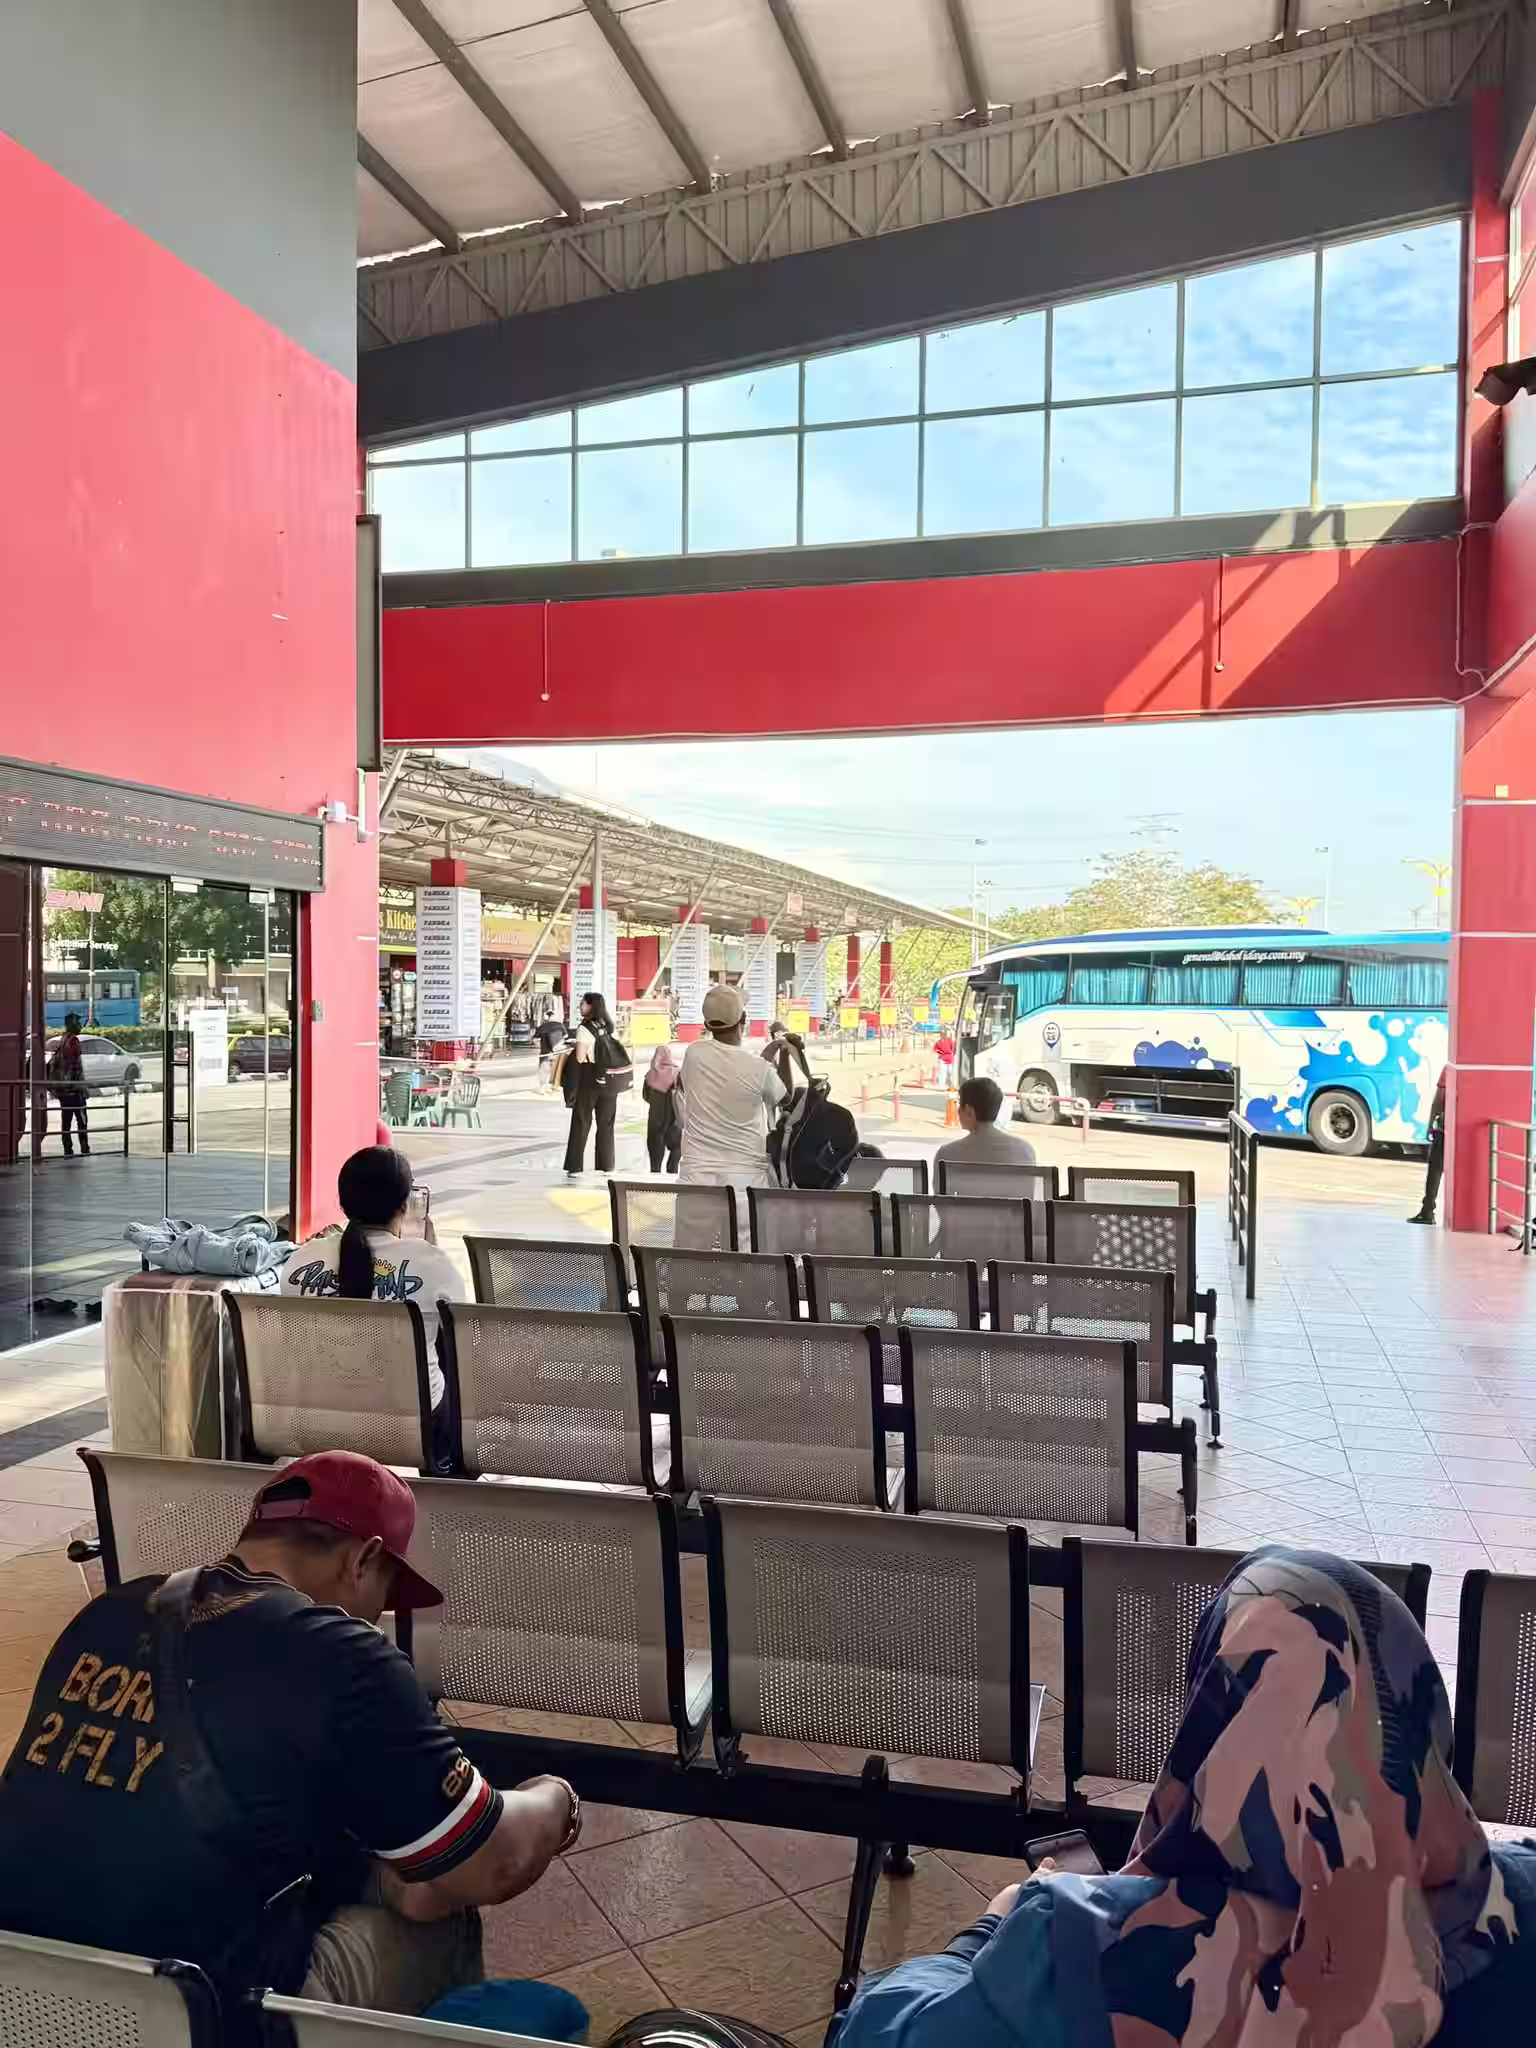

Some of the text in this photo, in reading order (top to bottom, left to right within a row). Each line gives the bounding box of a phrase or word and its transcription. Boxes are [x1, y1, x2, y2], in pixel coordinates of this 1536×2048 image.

[45, 889, 104, 912] SANI
[386, 909, 416, 931] Kitche
[49, 939, 119, 951] Customer Service
[59, 1652, 156, 1723] BOR
[25, 1712, 164, 1792] 2 FLY
